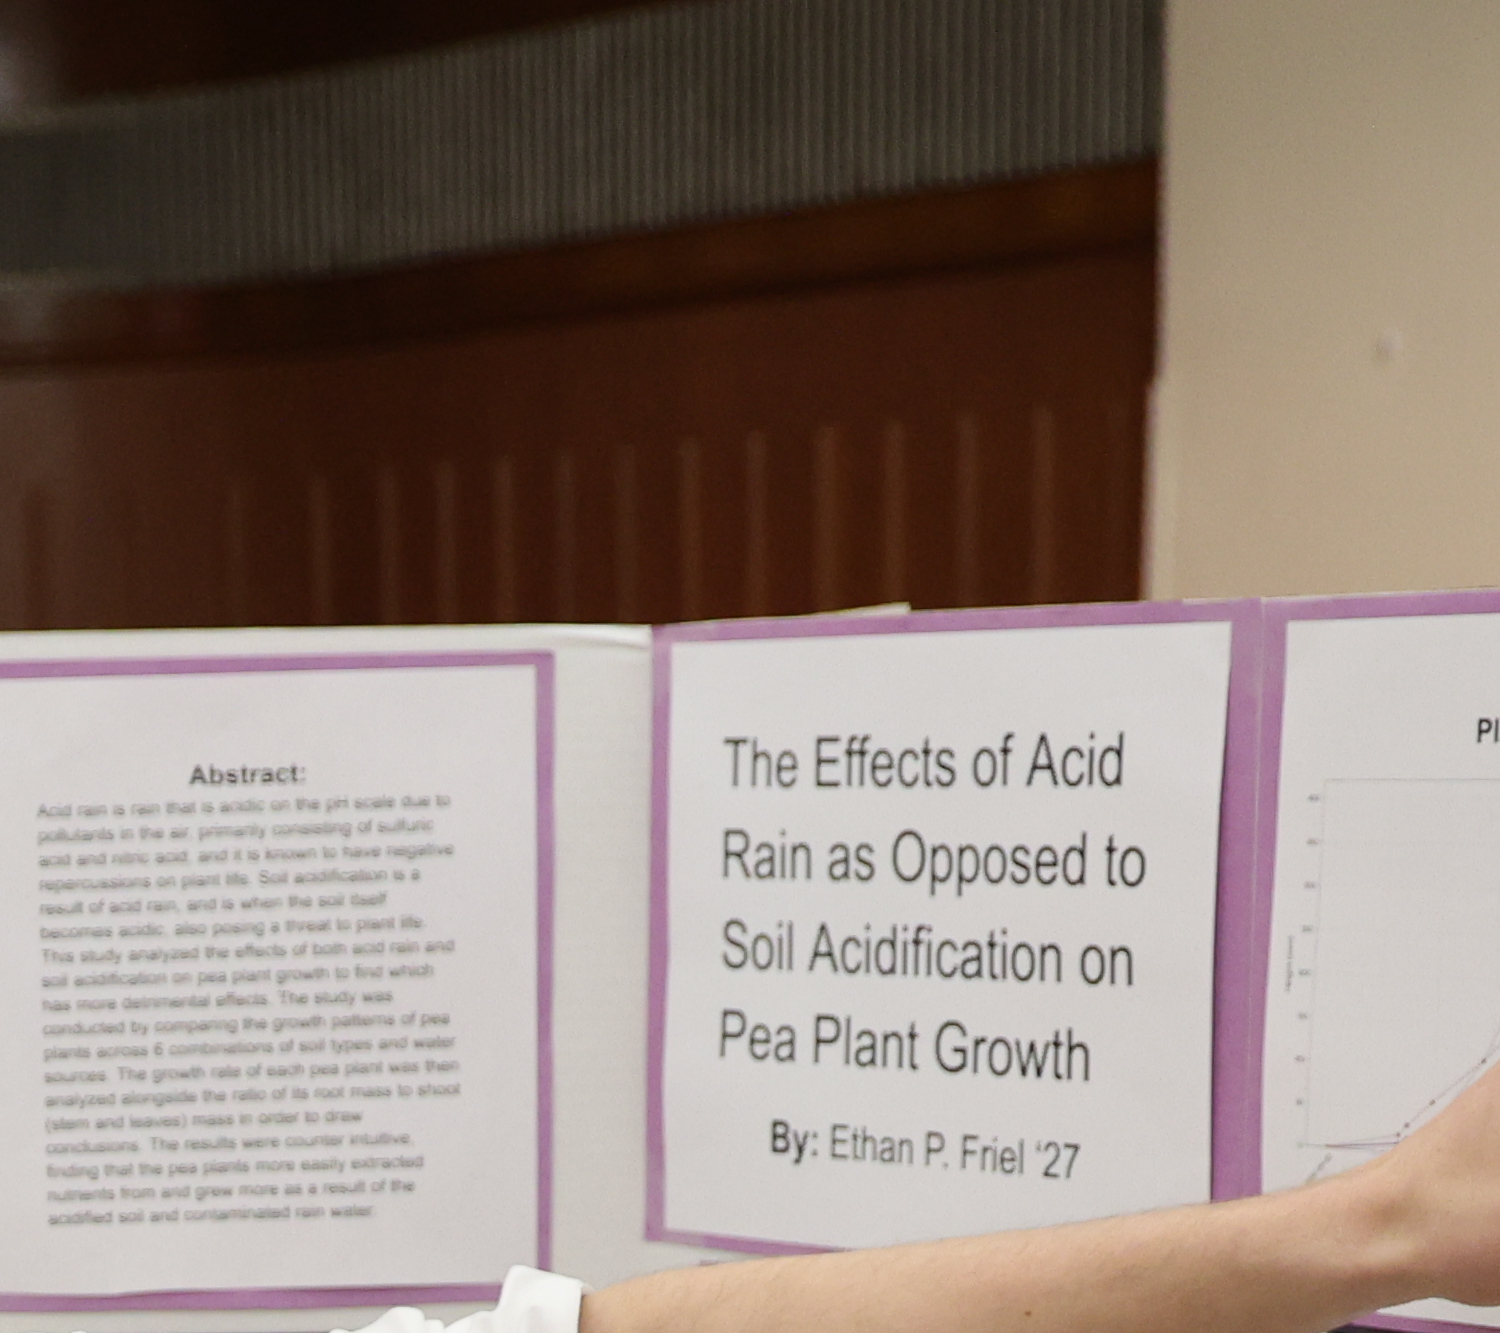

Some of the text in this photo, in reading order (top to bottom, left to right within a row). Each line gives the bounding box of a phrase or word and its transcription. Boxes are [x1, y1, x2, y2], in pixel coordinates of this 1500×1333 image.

[189, 765, 307, 786] Abstract:
[724, 732, 1124, 789] The Effects of Acid
[723, 829, 1146, 897] Rain as Opposed to
[723, 919, 1133, 986] Soil Acidification on
[720, 1009, 1090, 1081] Pea Plant Growth
[770, 1119, 818, 1165] By:
[830, 1124, 913, 1164] Ethan
[925, 1131, 948, 1167] P.
[961, 1134, 1024, 1175] Friel
